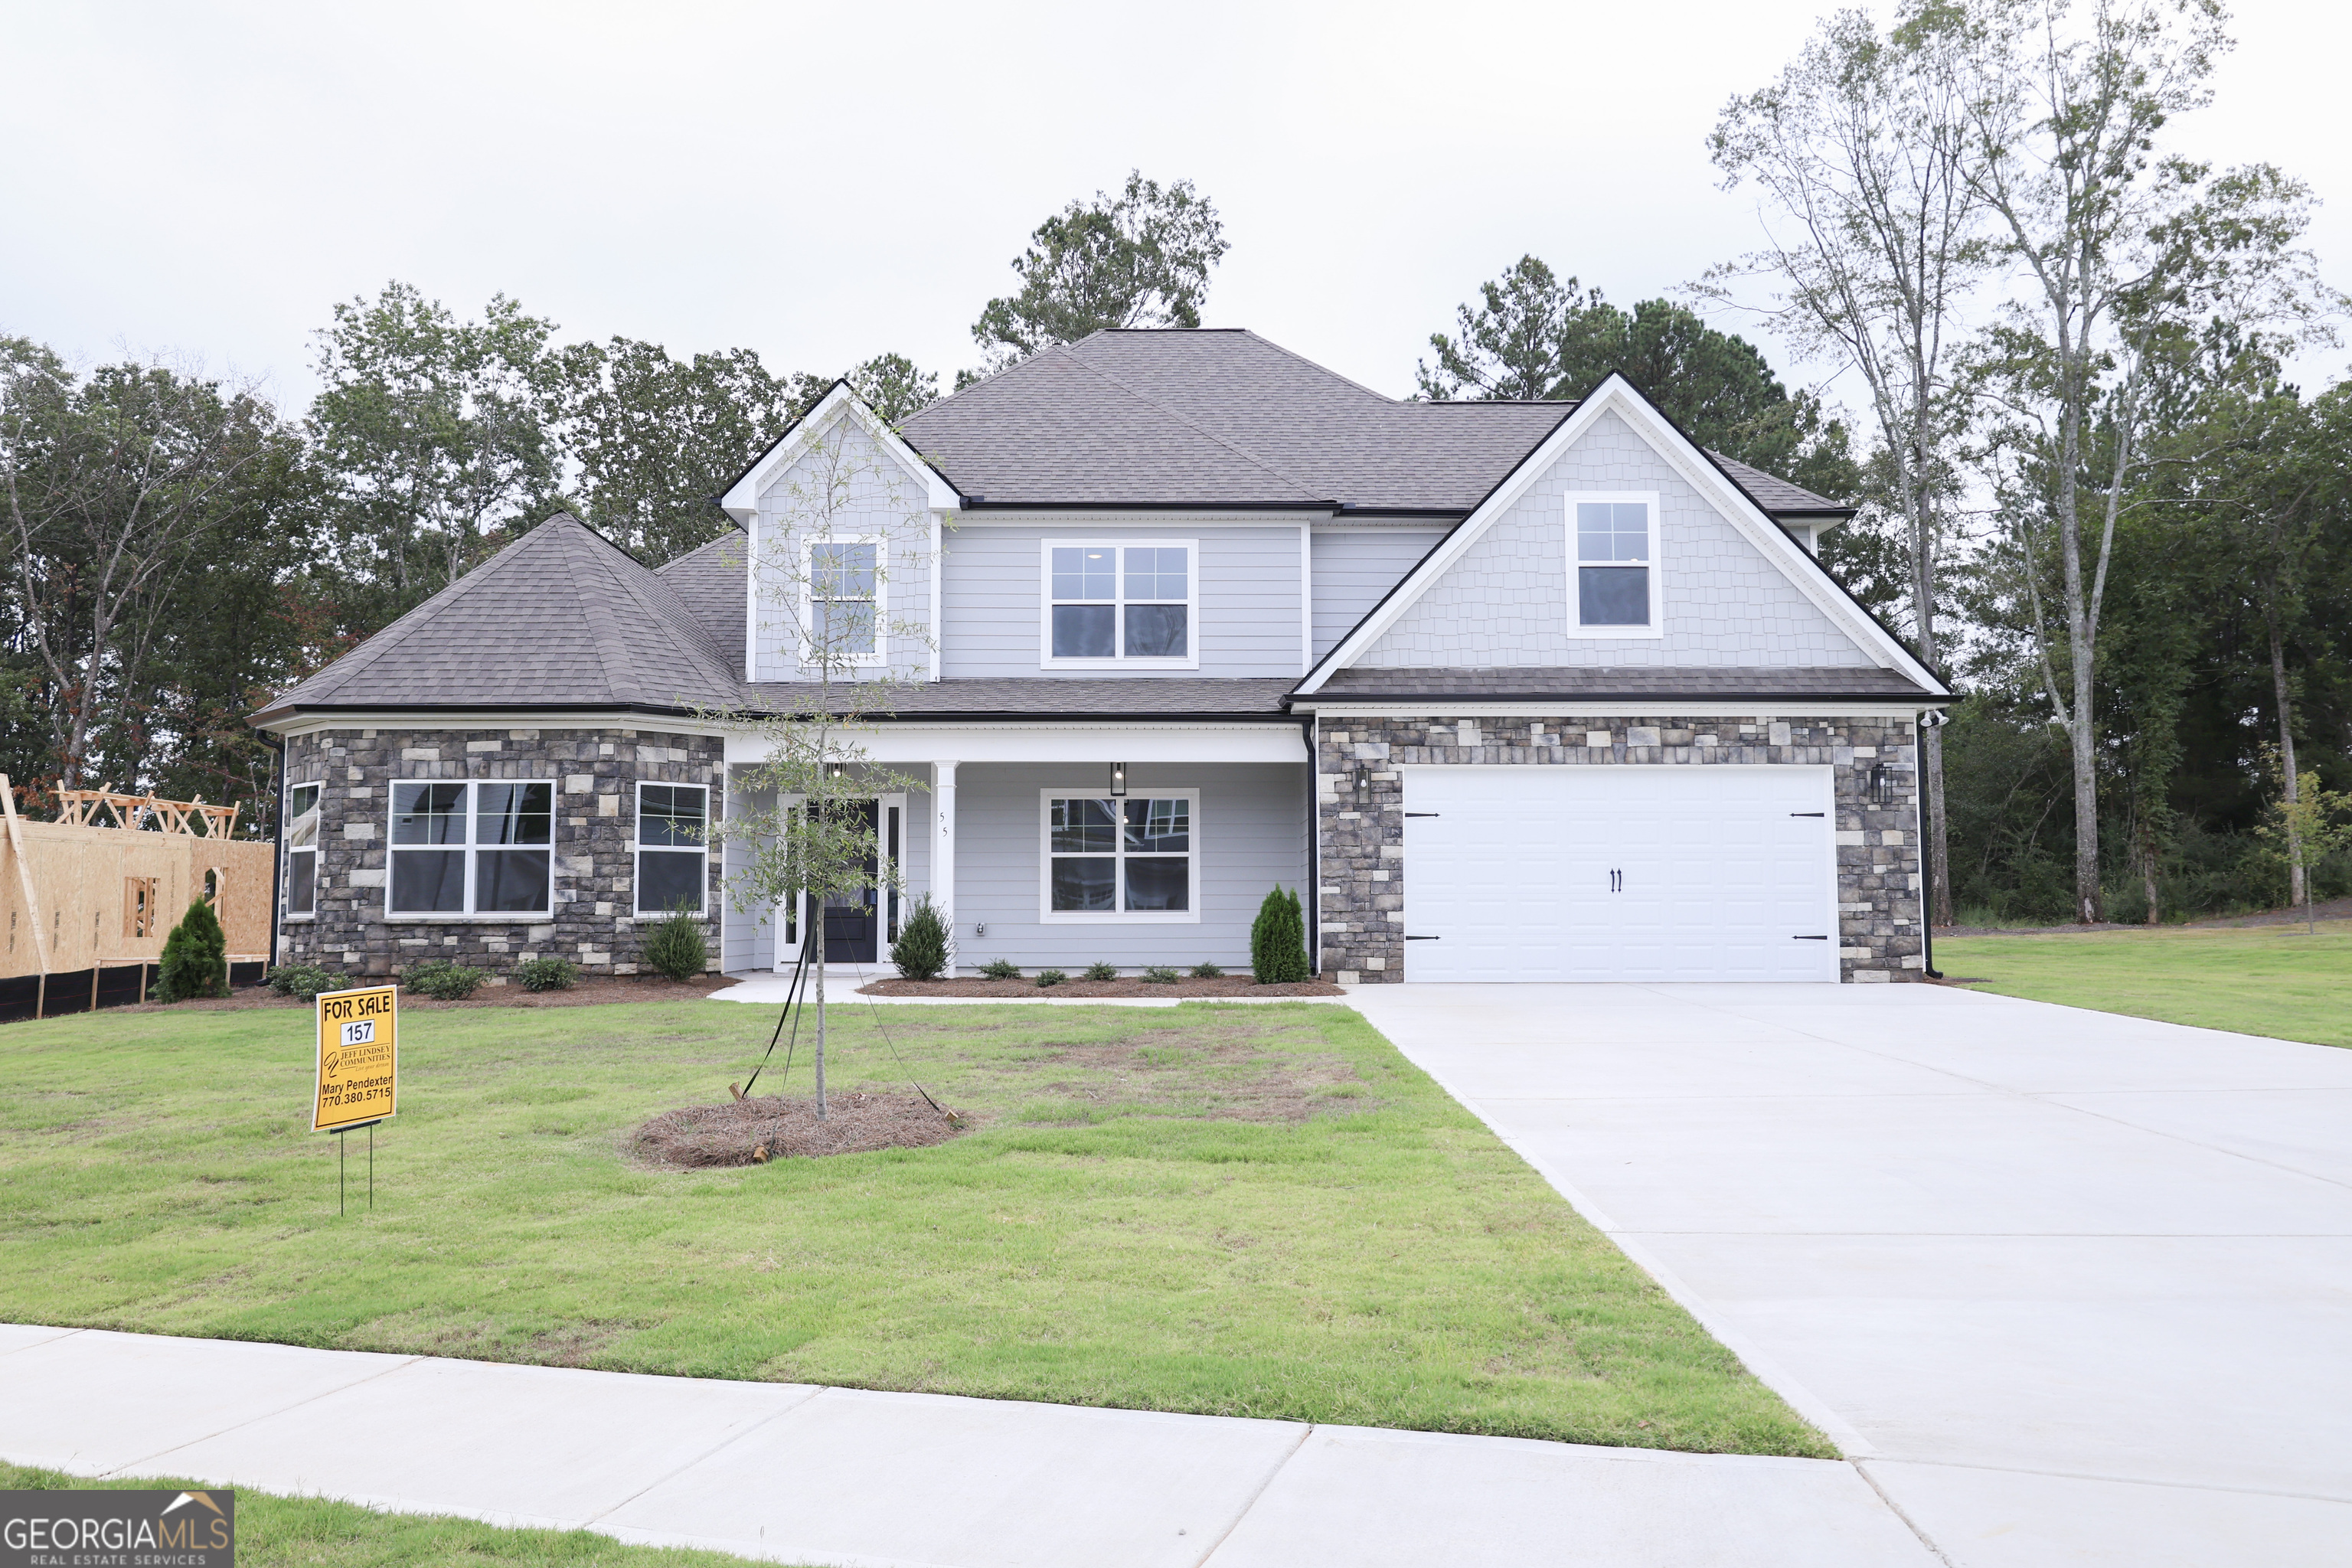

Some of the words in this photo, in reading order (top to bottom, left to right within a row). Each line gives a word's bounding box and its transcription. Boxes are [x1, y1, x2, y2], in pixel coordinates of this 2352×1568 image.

[324, 1000, 352, 1022] FOR
[358, 995, 390, 1016] SALE
[347, 1022, 372, 1041] 157
[340, 1050, 358, 1060] JEFF
[359, 1045, 390, 1057] LINDSEY
[340, 1054, 390, 1067] COMMUNITIES
[322, 1083, 344, 1096] Mary
[347, 1076, 393, 1091] Pendexter
[322, 1087, 391, 1108] 770.380.5715
